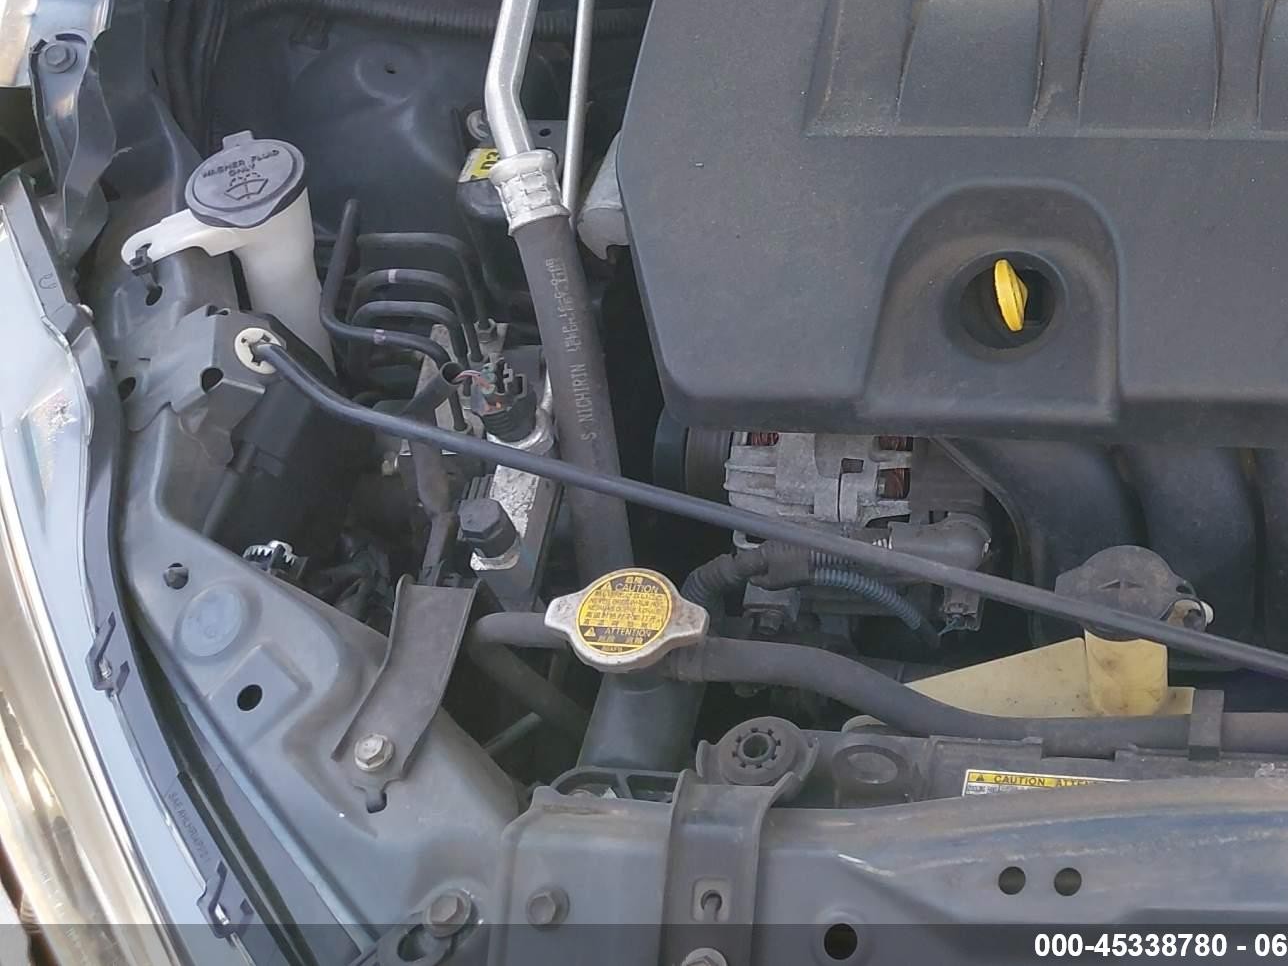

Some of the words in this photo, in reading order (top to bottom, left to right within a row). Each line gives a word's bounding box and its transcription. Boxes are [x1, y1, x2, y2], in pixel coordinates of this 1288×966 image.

[570, 363, 593, 424] NICHIRIN
[615, 583, 658, 593] CAUTION
[605, 628, 651, 637] ATTENTION
[993, 775, 1046, 786] CAUTION
